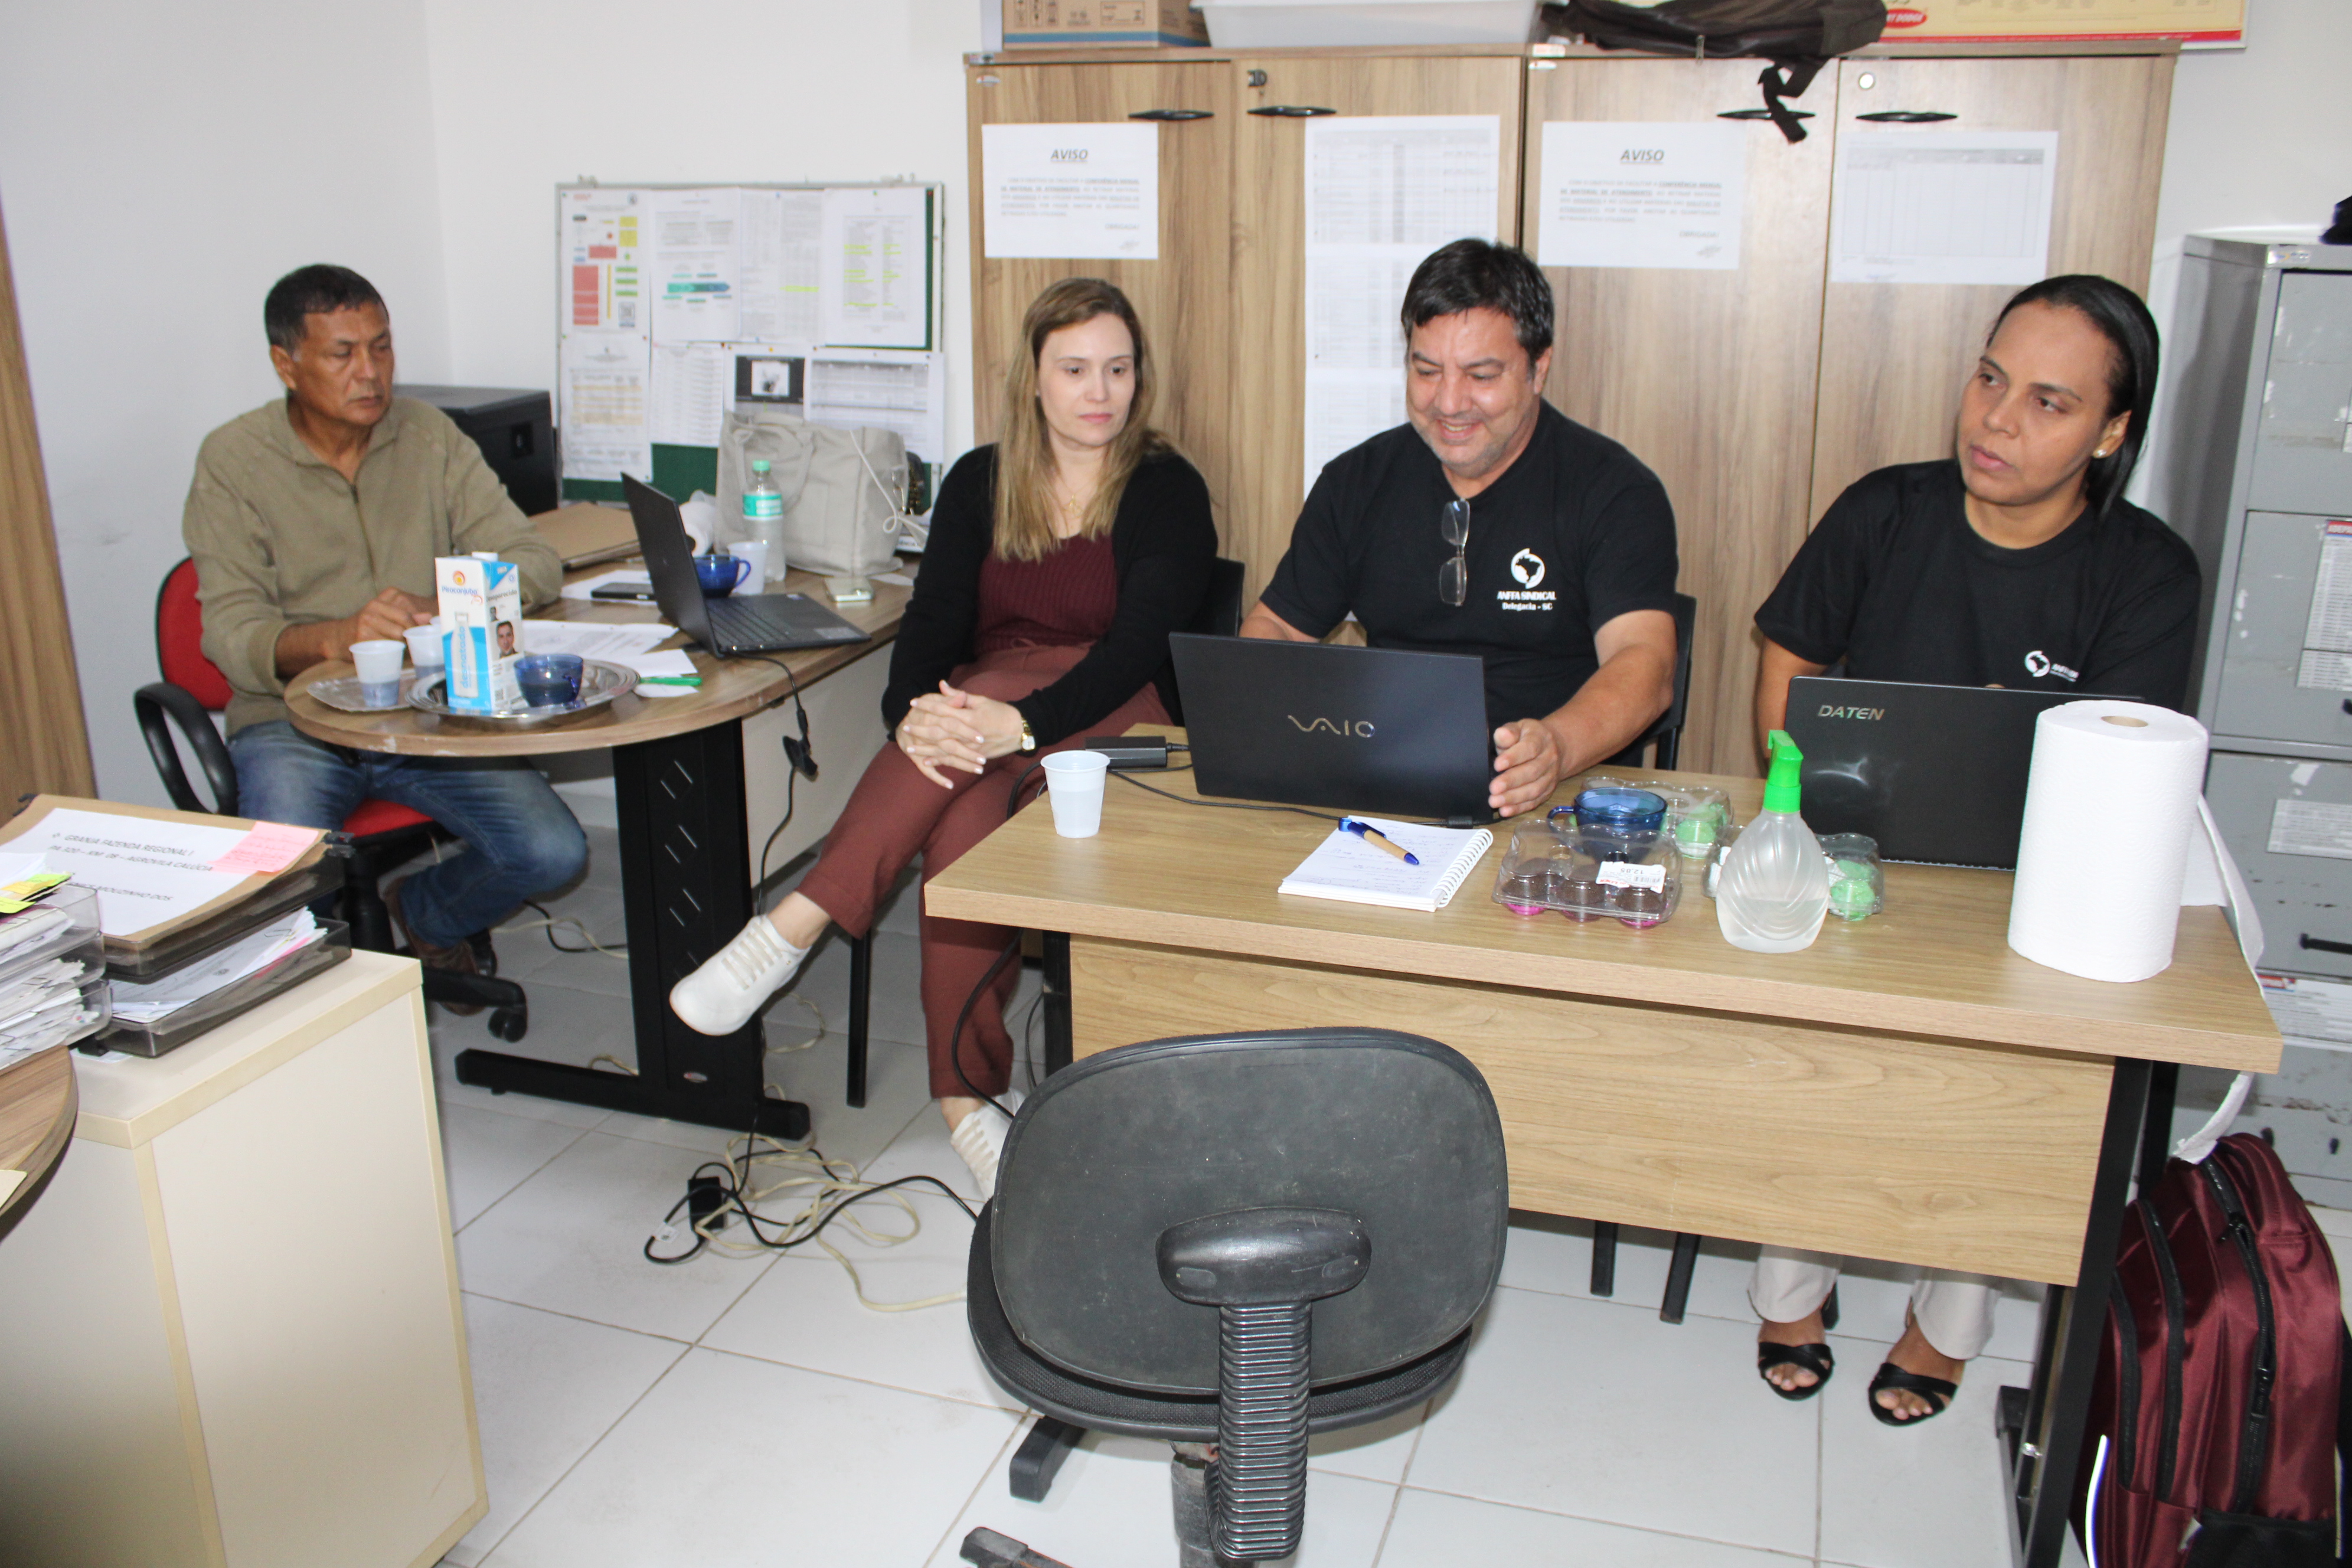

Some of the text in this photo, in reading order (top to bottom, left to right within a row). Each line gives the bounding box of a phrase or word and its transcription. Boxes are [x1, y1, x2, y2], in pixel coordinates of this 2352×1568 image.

[1051, 148, 1089, 161] AVISO
[1621, 149, 1665, 162] AVISO
[1497, 591, 1557, 600] ANFFA SINDICAL
[1502, 602, 1536, 612] Delegacia
[1541, 602, 1553, 610] SC
[458, 626, 468, 688] desnatado
[1817, 705, 1885, 721] DATEN
[1288, 715, 1375, 738] VAIO
[64, 834, 100, 845] GRANJA
[100, 838, 141, 850] FAZENDA
[141, 844, 188, 856] REGIONAL
[126, 855, 173, 867] AGROVILA
[150, 893, 174, 901] DOS
